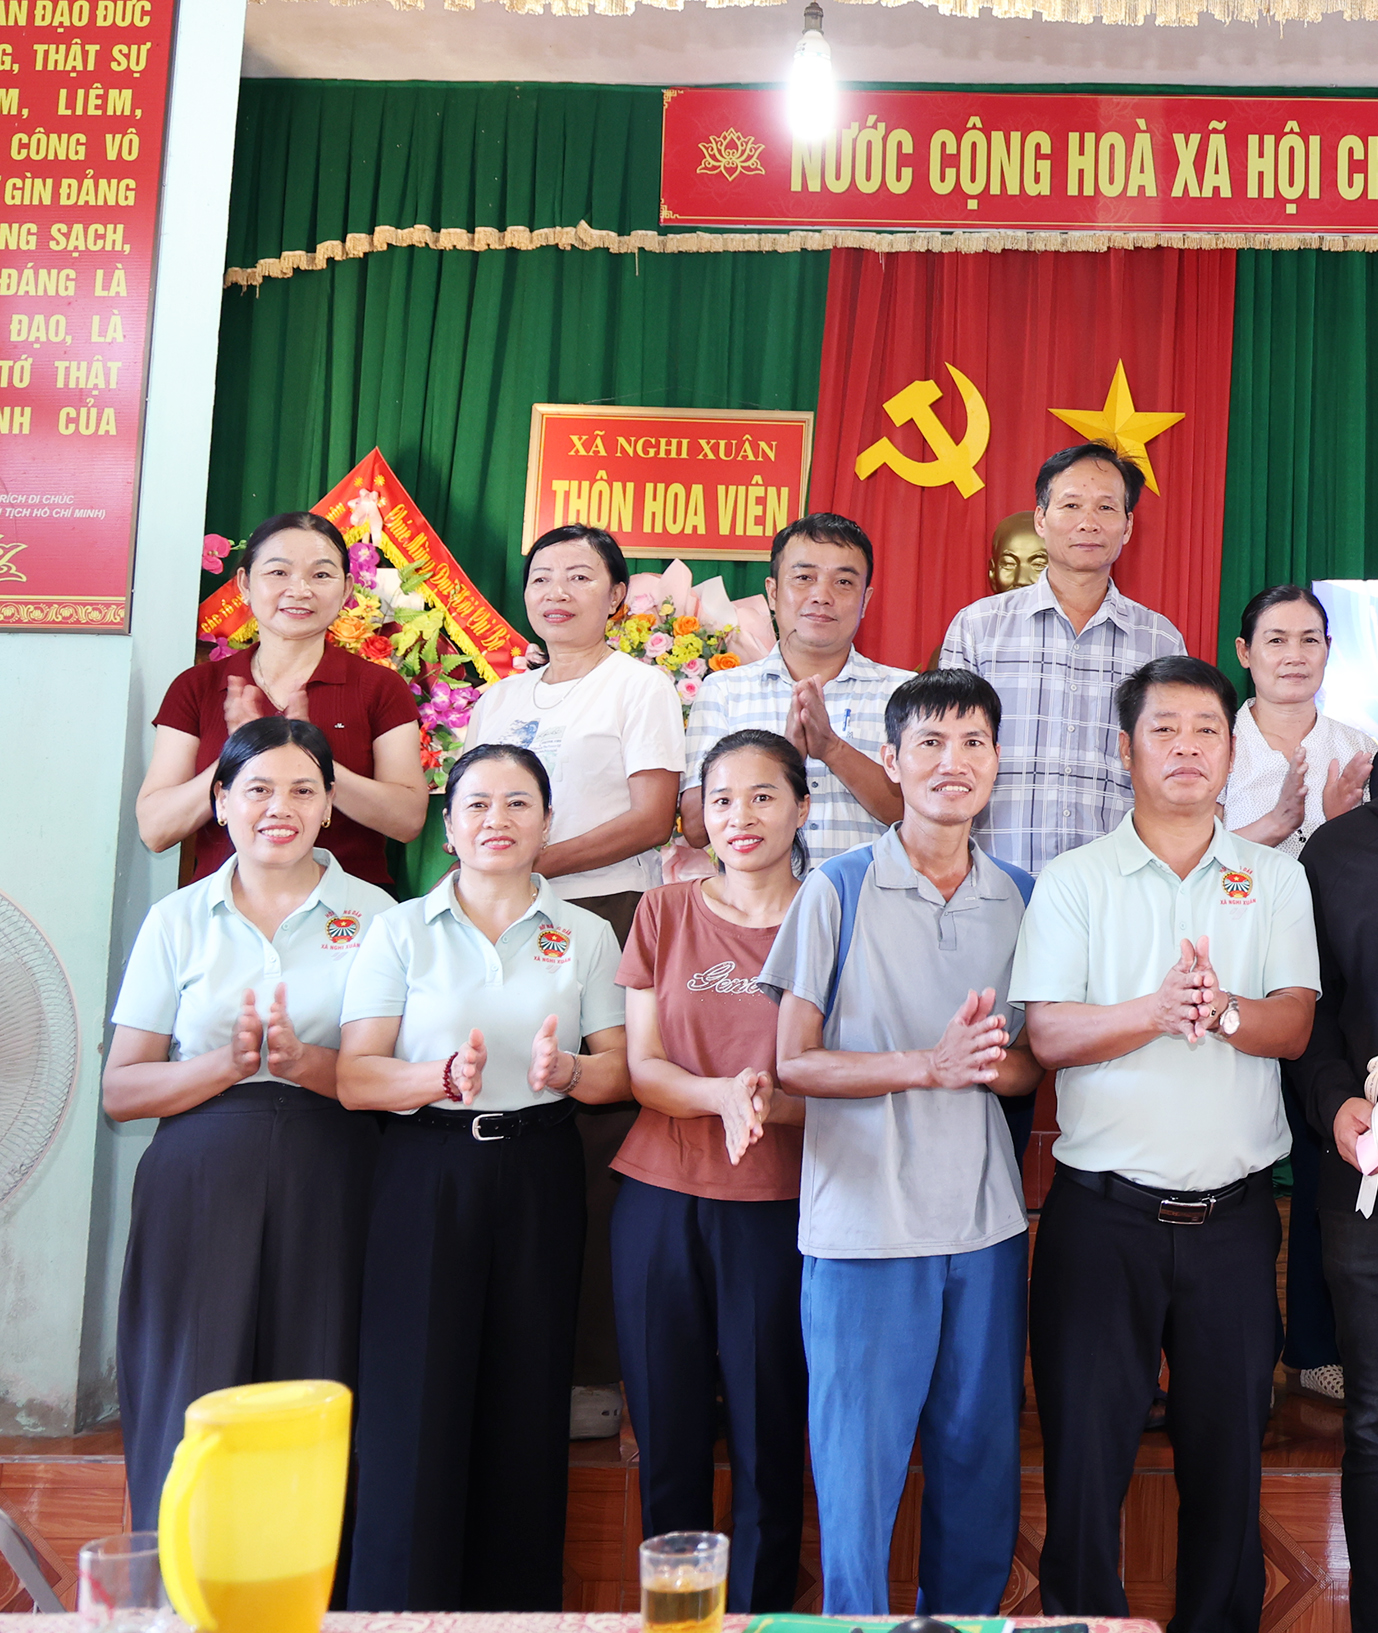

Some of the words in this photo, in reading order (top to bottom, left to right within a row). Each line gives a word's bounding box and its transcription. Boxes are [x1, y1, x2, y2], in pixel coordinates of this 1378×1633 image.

[34, 0, 90, 33] ĐẠO
[33, 39, 101, 77] THẬT
[110, 42, 152, 78] SỰ
[57, 83, 142, 119] LIÊM,
[11, 128, 86, 160] CÔNG
[105, 128, 140, 161] VÔ
[790, 114, 914, 195] NƯỚC
[929, 116, 1052, 210] CỘNG
[1067, 118, 1158, 198] HOÀ
[1171, 120, 1232, 199] XÃ
[1247, 121, 1321, 214] HỘI
[4, 172, 54, 206] GÌN
[59, 169, 137, 207] ĐẢNG
[49, 223, 131, 257] SẠCH,
[0, 262, 76, 297] ĐÁNG
[94, 263, 127, 297] LÀ
[10, 314, 72, 348] ĐẠO,
[91, 310, 124, 343] LÀ
[0, 354, 33, 389] TỚ
[55, 355, 122, 395] THẬT
[58, 397, 117, 436] CỦA
[567, 430, 608, 457] XÃ
[615, 436, 690, 459] NGHI
[696, 434, 778, 462] XUÂN
[5, 508, 31, 519] TỊCH
[32, 506, 50, 517] HỒ
[52, 506, 73, 518] CHÍ
[74, 509, 106, 520] MINH)
[28, 494, 40, 504] DI
[42, 492, 74, 504] CHÚC
[551, 469, 635, 533] THÔN
[643, 482, 706, 535] HOA
[717, 475, 789, 537] VIÊN
